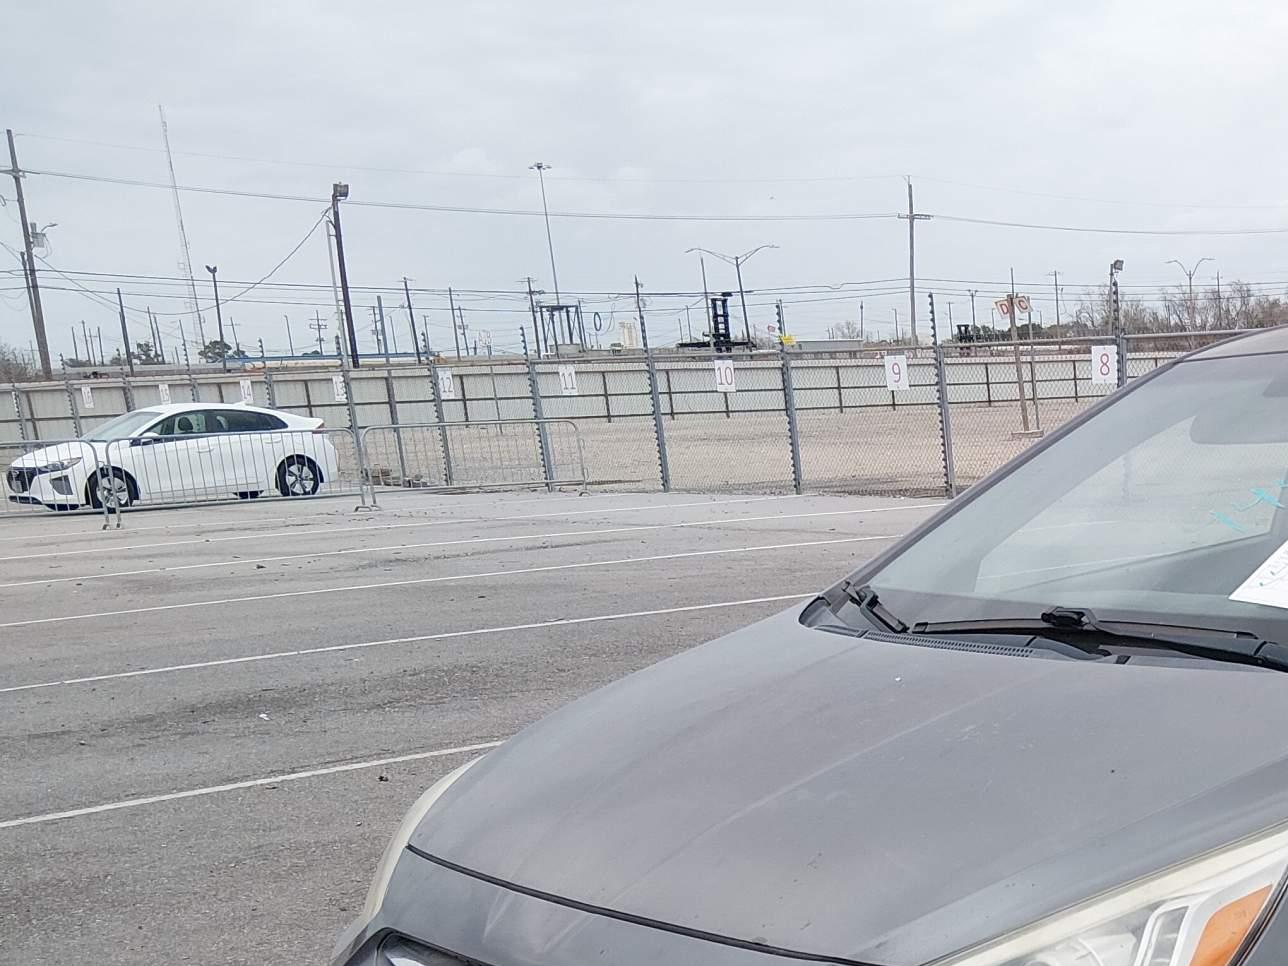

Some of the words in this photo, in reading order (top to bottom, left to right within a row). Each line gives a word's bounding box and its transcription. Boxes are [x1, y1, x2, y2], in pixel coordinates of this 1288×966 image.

[891, 362, 901, 383] 9
[1099, 352, 1110, 376] 8
[441, 372, 453, 393] 12
[562, 371, 576, 391] 11
[717, 366, 734, 385] 10
